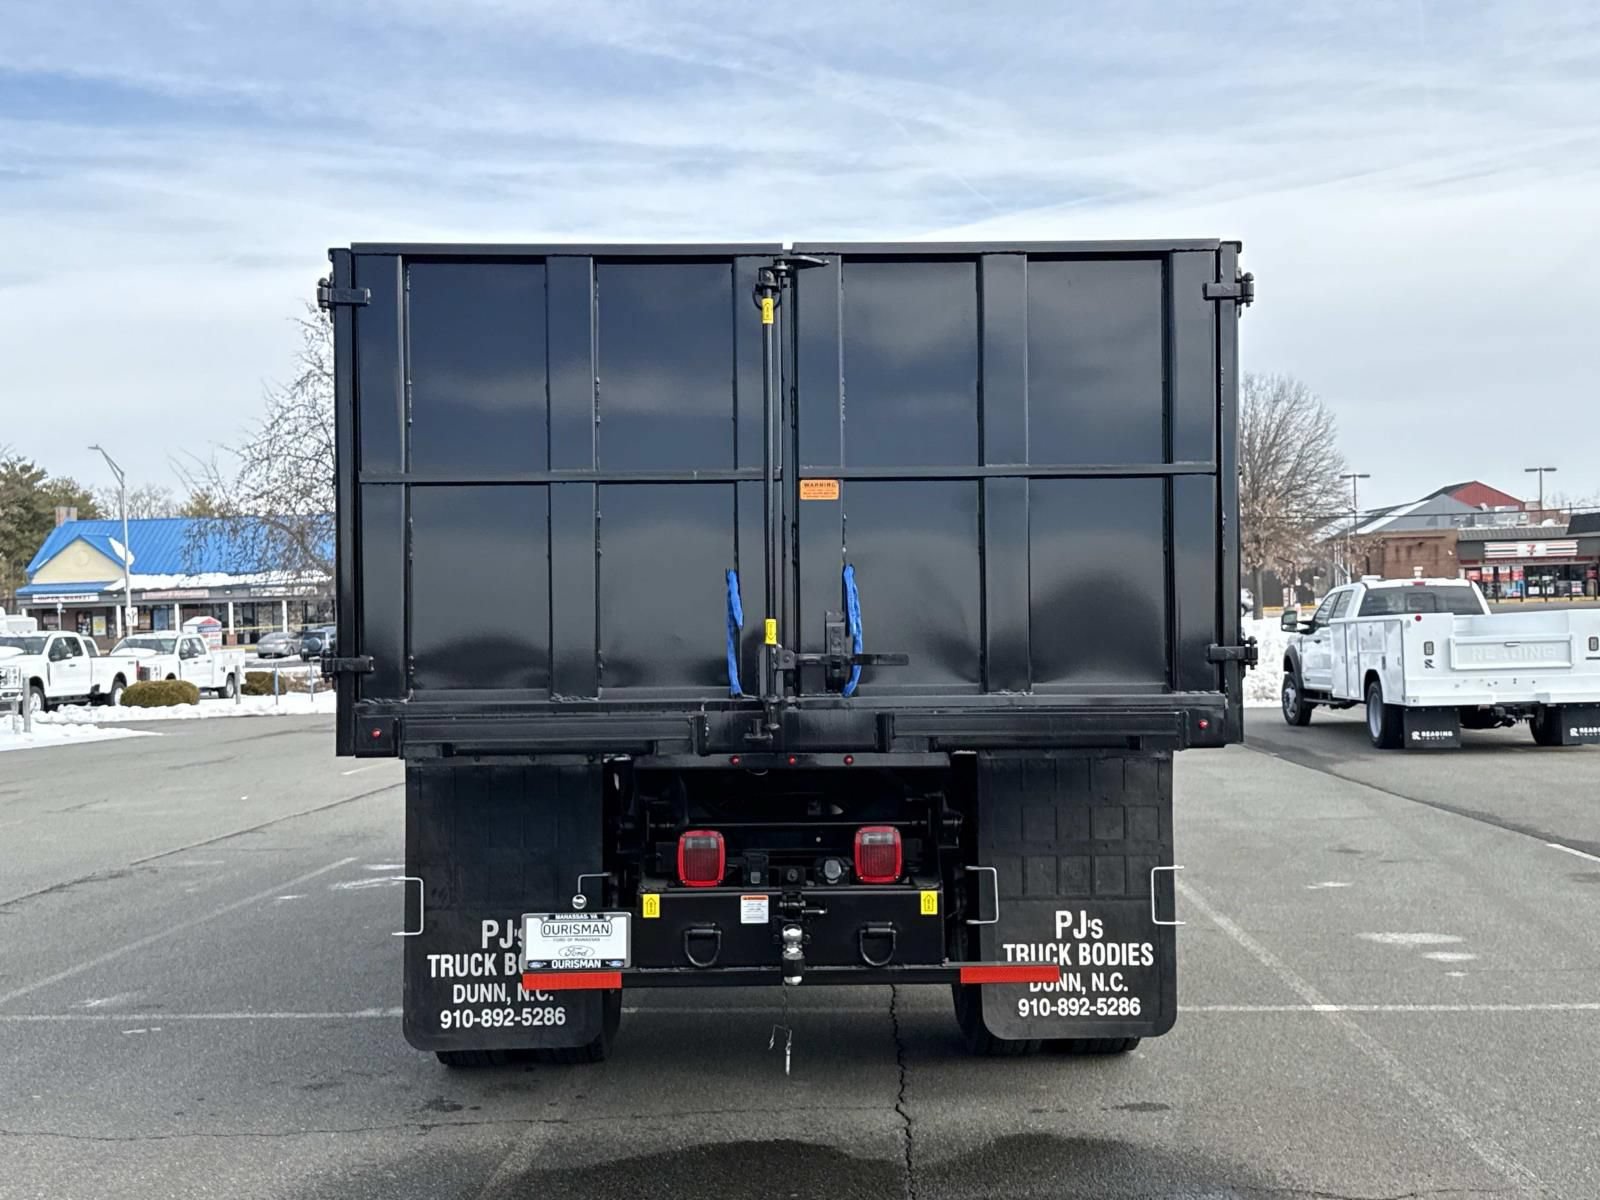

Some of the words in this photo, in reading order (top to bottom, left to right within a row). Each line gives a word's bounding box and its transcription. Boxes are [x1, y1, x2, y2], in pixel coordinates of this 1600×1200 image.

[543, 924, 609, 935] OURISMAN
[564, 946, 588, 957] Ford
[1003, 943, 1072, 966] TRUCK
[1078, 942, 1154, 966] BODIES
[427, 953, 497, 978] TRUCK
[552, 960, 601, 969] OURISMAN
[1091, 972, 1128, 992] N.C.
[453, 983, 511, 1005] DUNN,
[1018, 997, 1141, 1017] 910-892-5286
[440, 1007, 566, 1029] 910-892-5286
